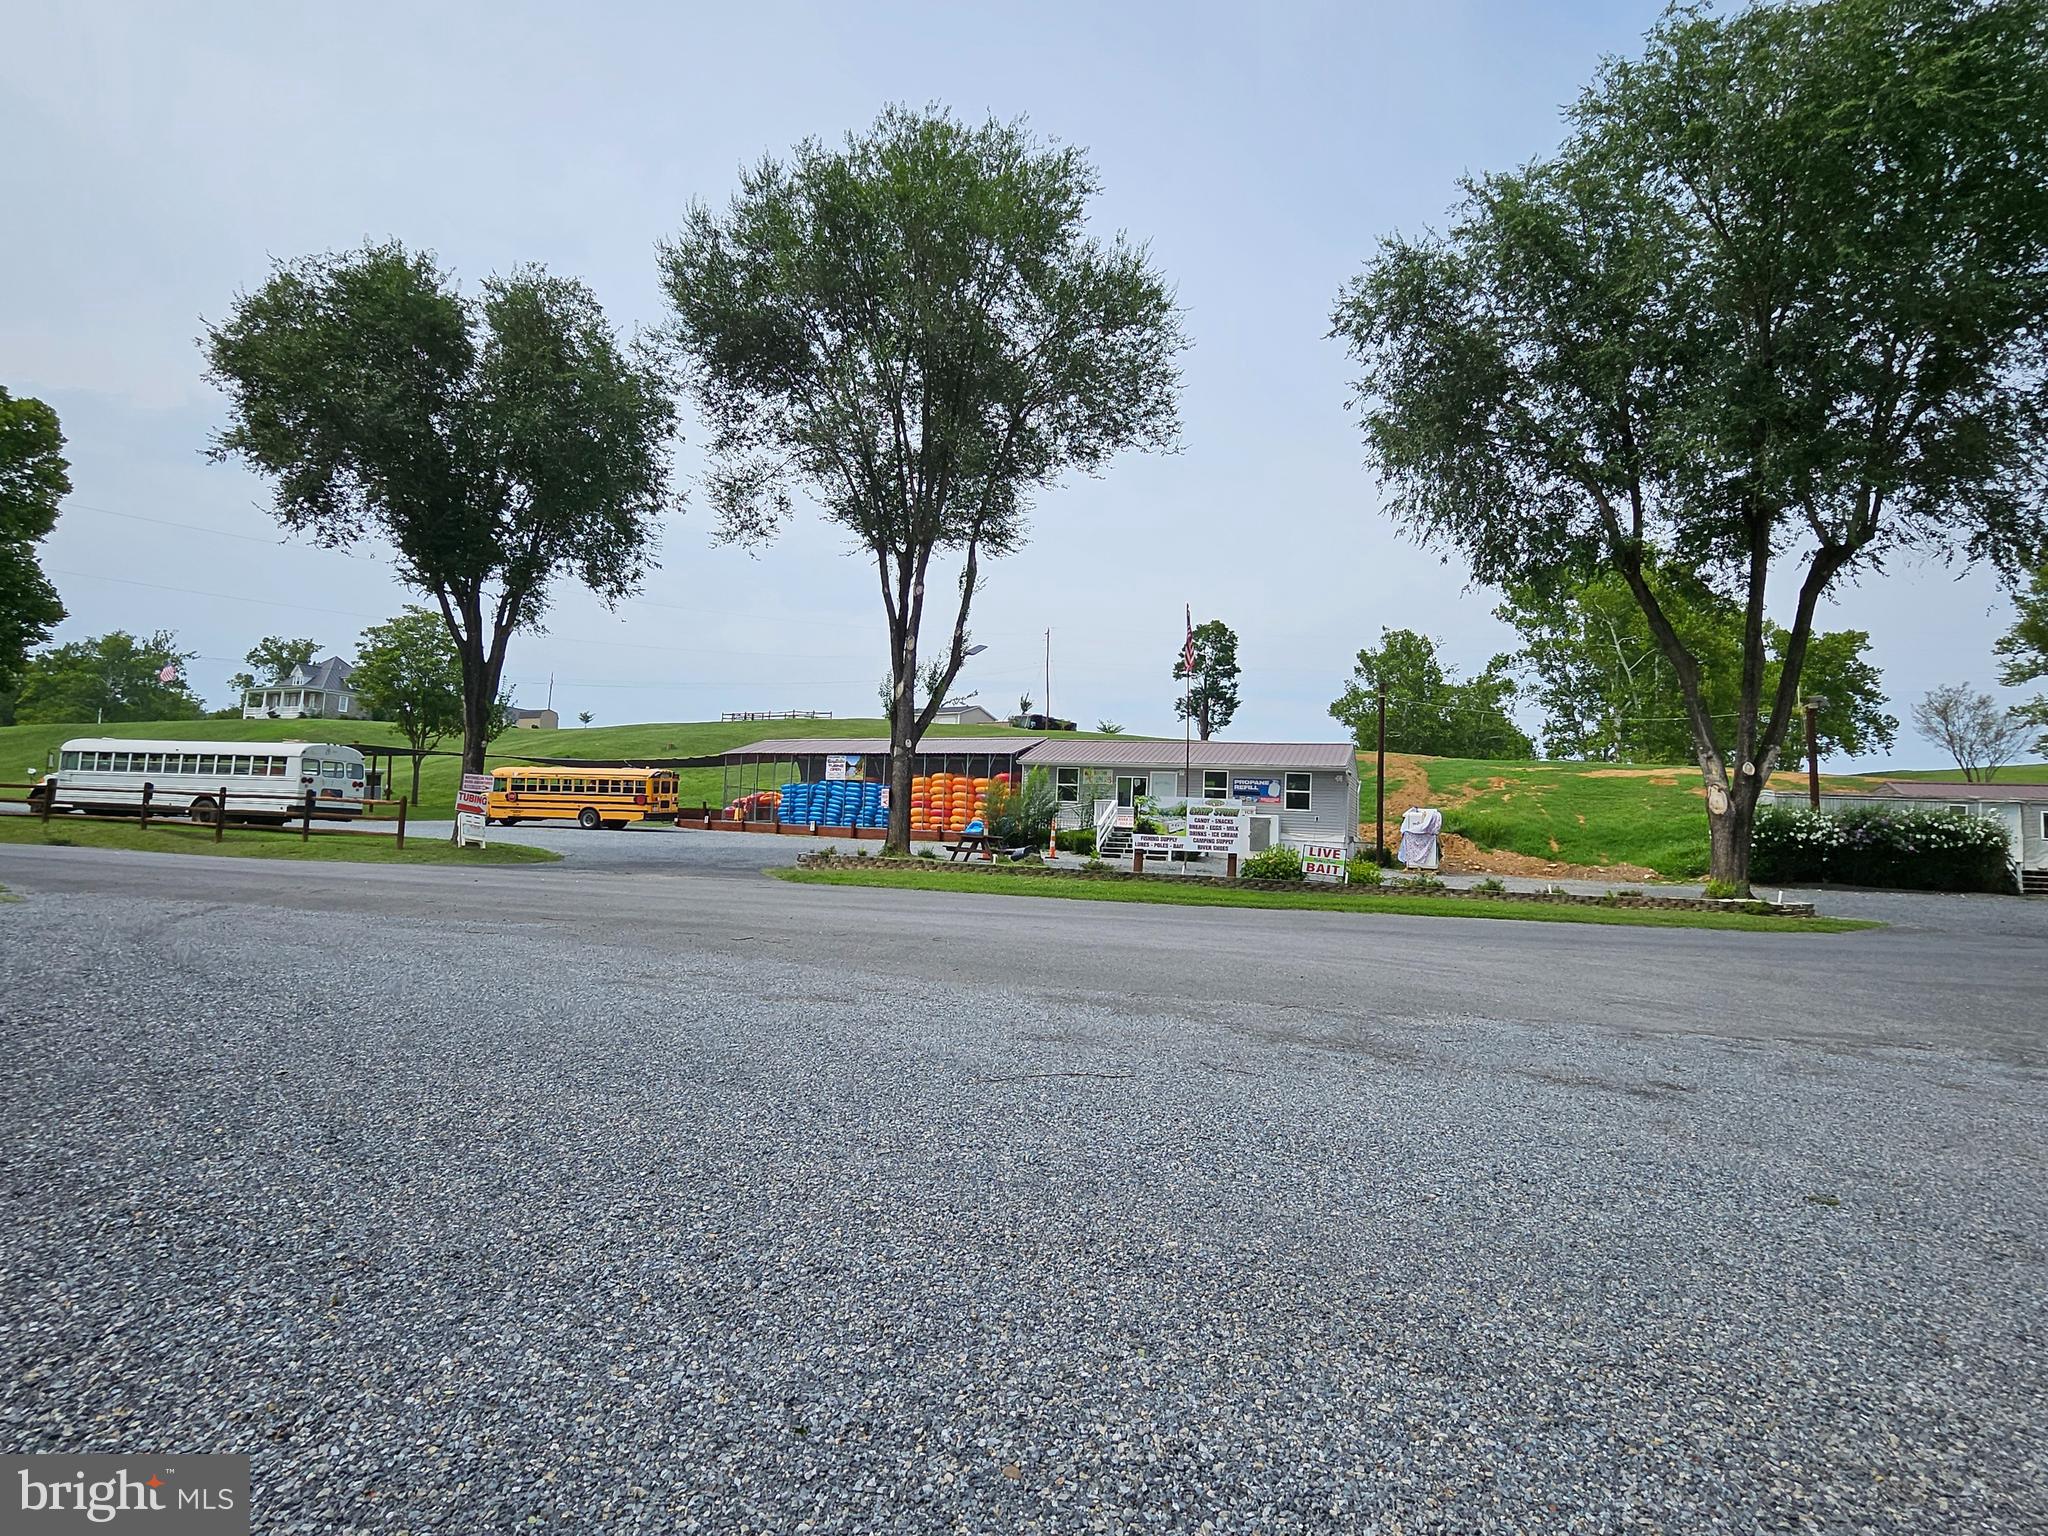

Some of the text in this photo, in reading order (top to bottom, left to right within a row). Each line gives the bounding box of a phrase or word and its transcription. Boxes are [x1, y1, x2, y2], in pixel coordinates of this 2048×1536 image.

[459, 792, 487, 805] TUBING
[1309, 846, 1341, 859] LIVE
[1306, 862, 1340, 875] BAIT
